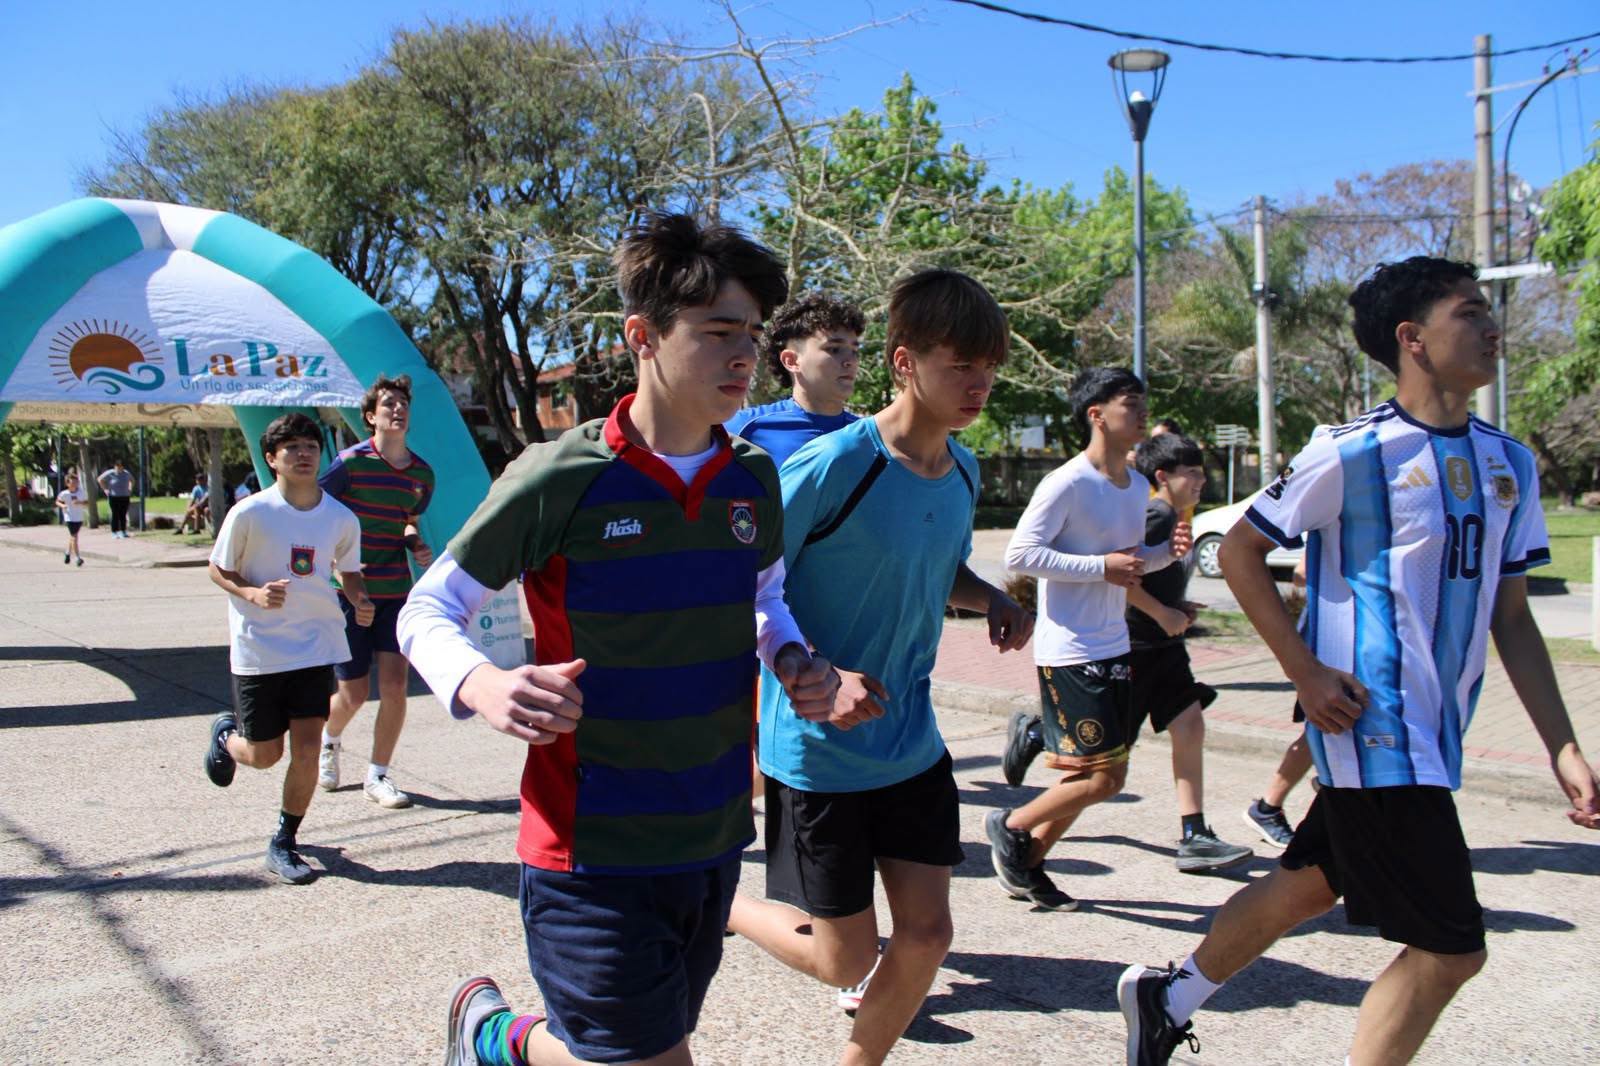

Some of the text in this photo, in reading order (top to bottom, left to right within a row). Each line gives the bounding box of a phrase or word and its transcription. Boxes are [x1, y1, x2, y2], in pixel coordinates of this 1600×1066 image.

[171, 337, 327, 378] La Paz
[181, 379, 199, 391] Un
[226, 379, 243, 390] de
[602, 519, 642, 539] flash
[1446, 513, 1484, 580] 10
